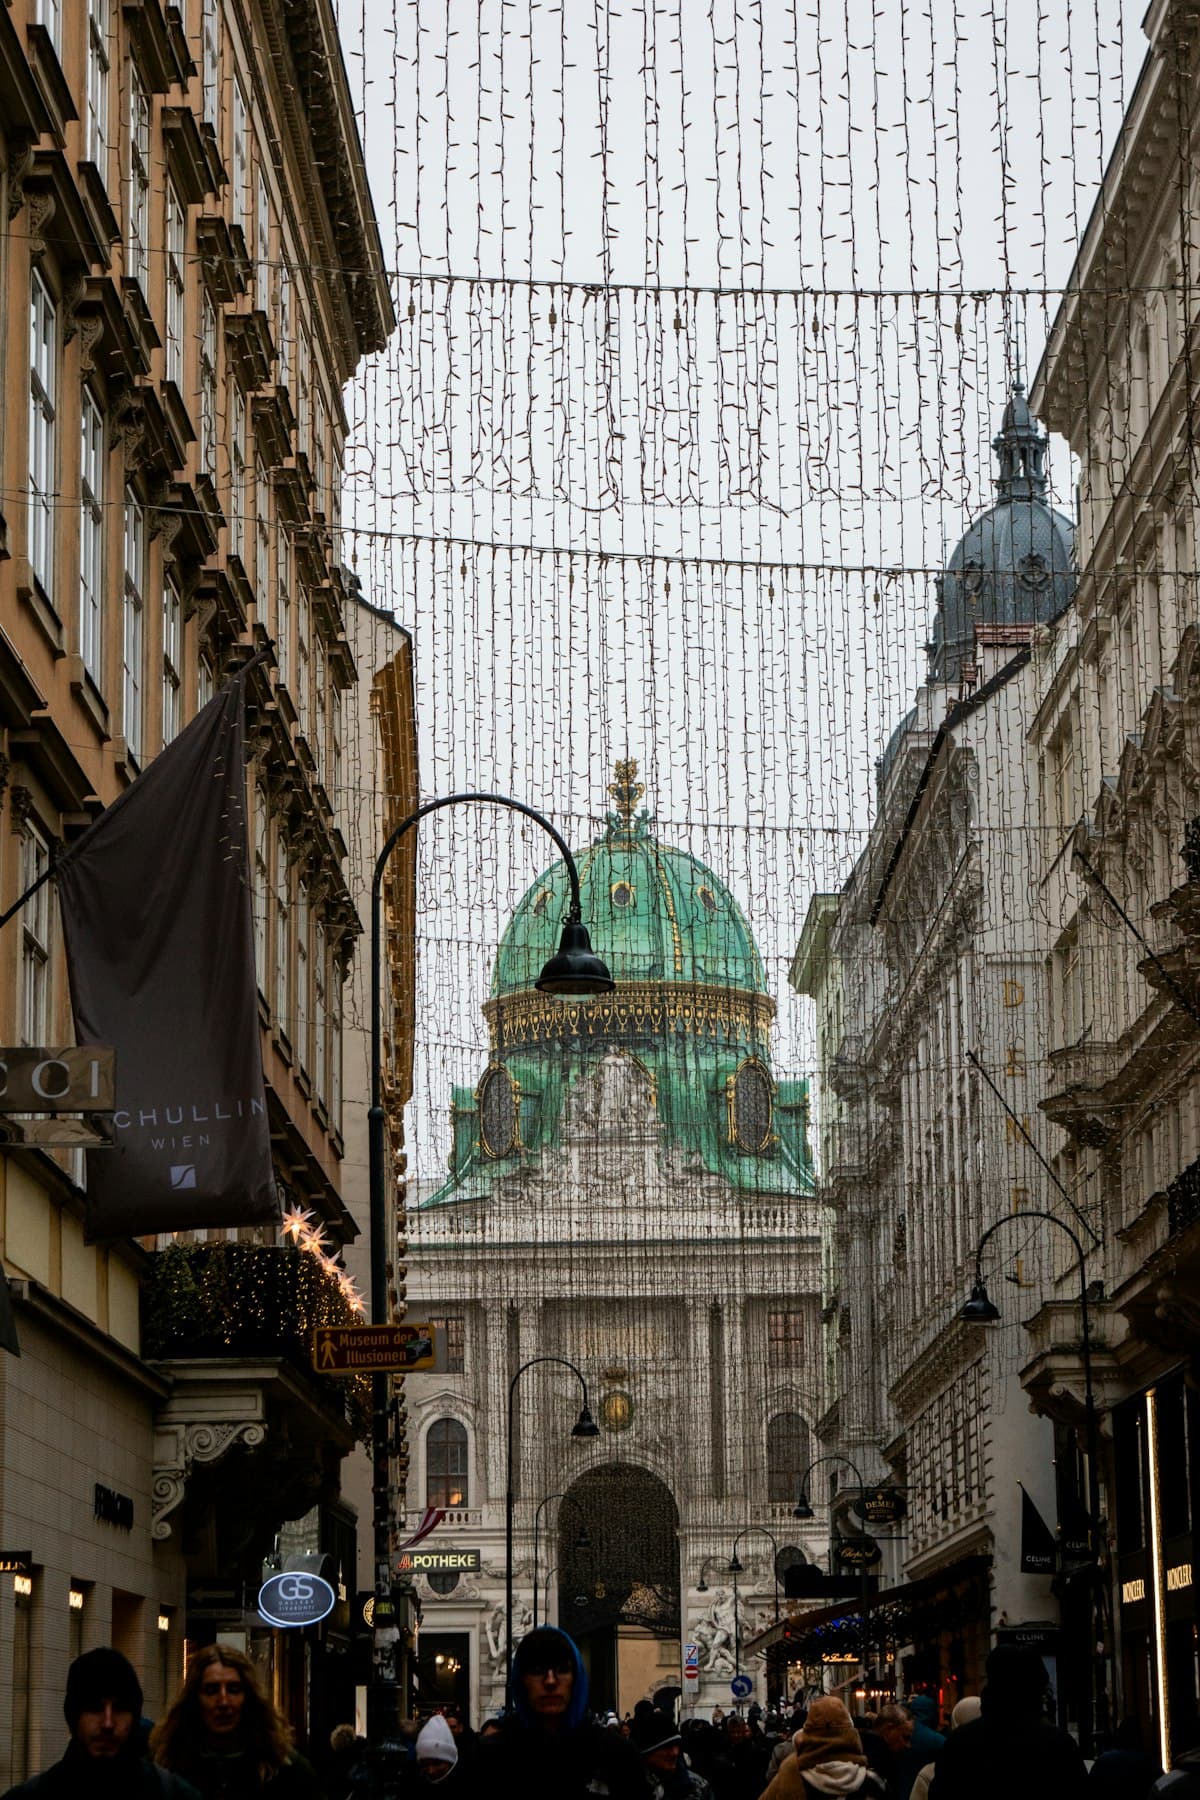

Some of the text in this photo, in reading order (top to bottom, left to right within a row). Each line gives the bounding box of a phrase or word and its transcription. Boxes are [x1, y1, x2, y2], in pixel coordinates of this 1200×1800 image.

[0, 1059, 100, 1098] CI
[112, 1096, 265, 1129] CHULLIN
[151, 1134, 211, 1151] WIEN
[1004, 980, 1035, 1288] DEMEL
[339, 1331, 413, 1346] Museum der
[346, 1349, 407, 1364] Illusionen
[397, 1552, 477, 1569] APOTHEKE
[1025, 1555, 1052, 1563] CELINE
[278, 1575, 314, 1600] GS
[1015, 1631, 1048, 1641] CELINE
